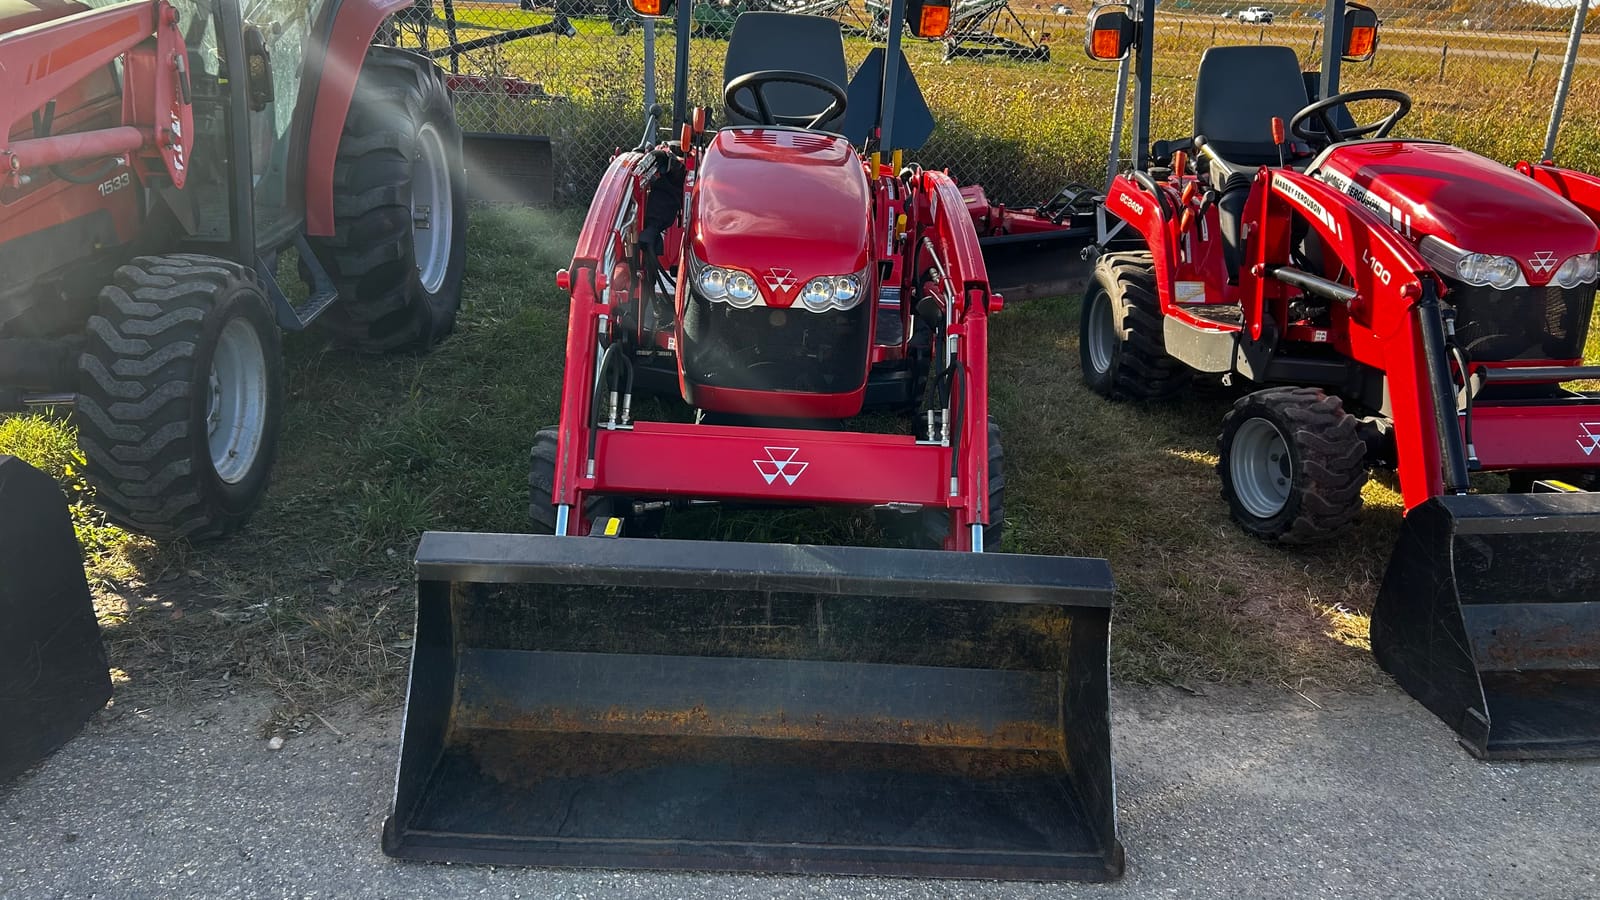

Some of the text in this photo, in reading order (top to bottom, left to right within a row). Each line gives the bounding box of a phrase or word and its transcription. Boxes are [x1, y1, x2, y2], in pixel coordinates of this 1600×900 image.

[98, 172, 130, 197] 1533
[1274, 178, 1322, 215] MASSEY FERGUSON
[1362, 248, 1391, 286] L100
